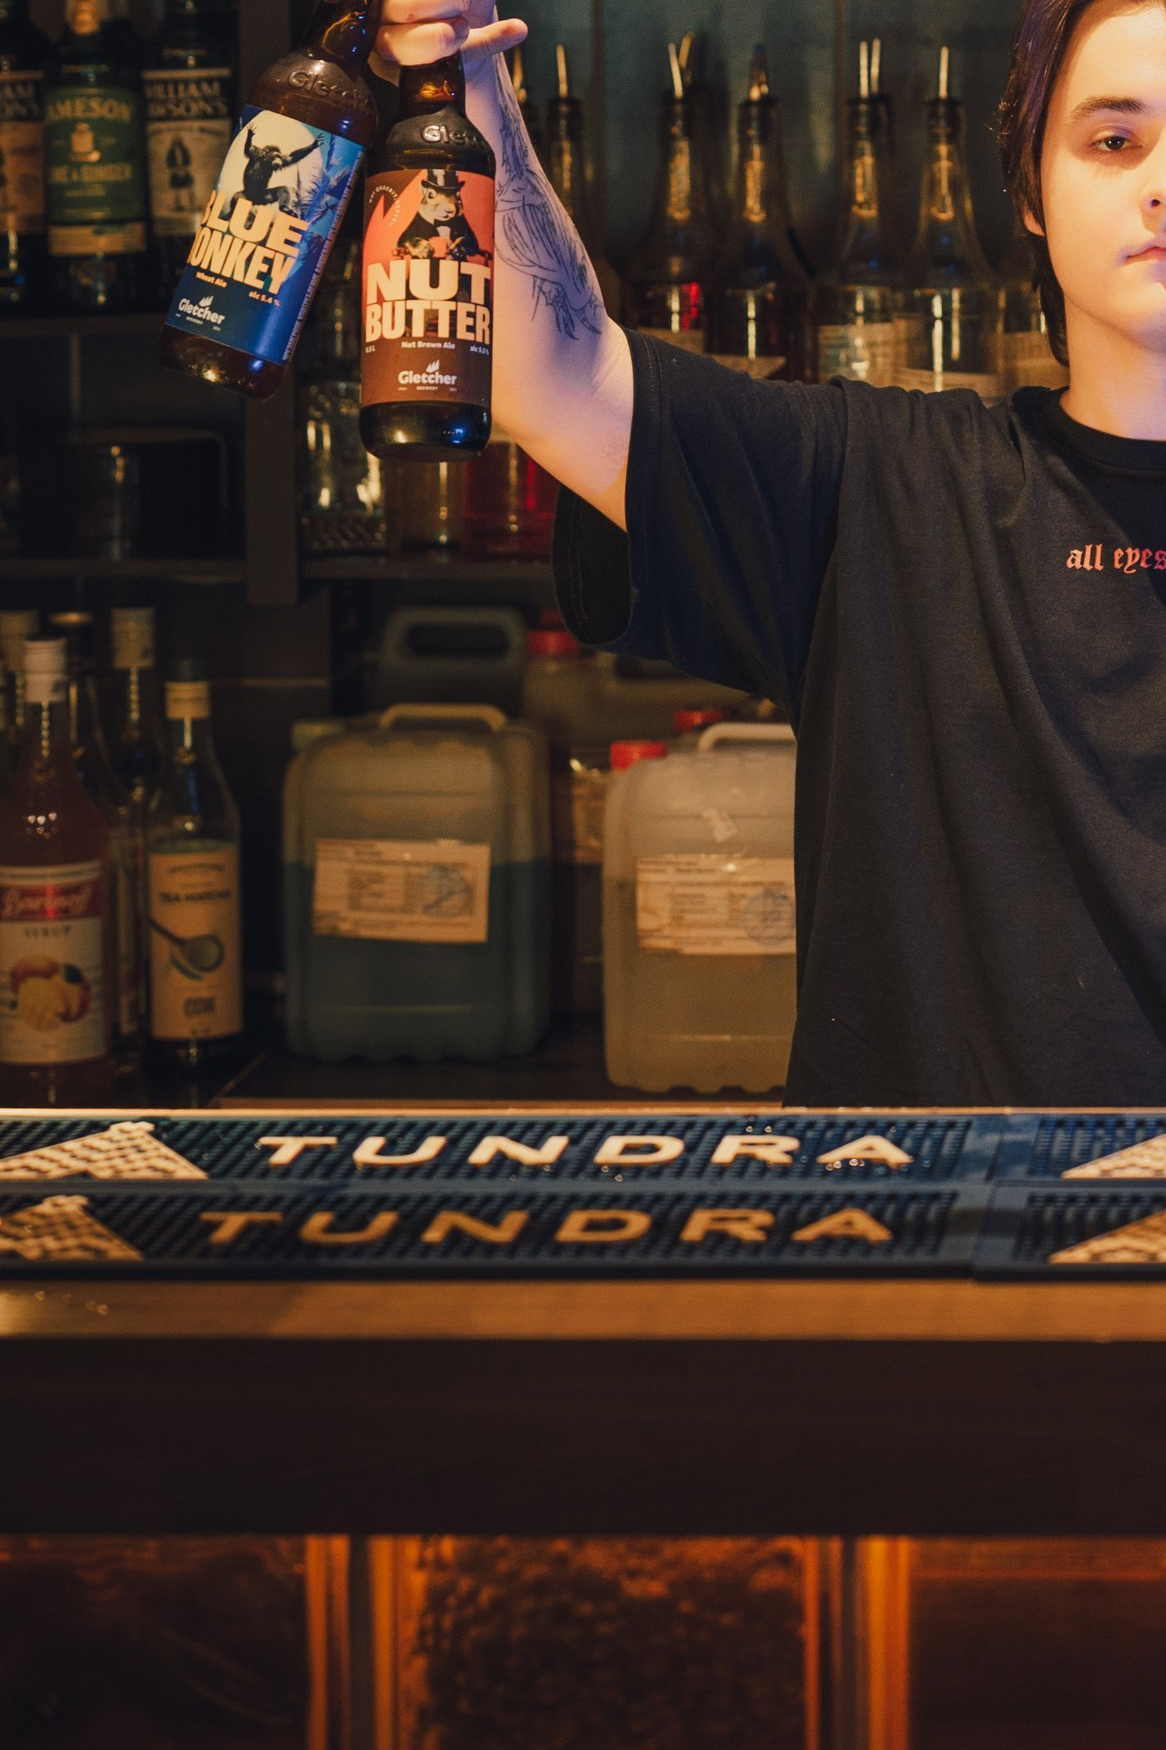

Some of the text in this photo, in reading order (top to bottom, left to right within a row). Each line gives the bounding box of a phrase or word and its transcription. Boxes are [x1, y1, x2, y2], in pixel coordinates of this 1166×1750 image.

[46, 97, 131, 122] AMESON
[186, 224, 296, 295] ONKEY
[367, 258, 491, 306] NUT
[178, 298, 225, 325] Gletcher
[365, 299, 491, 345] BUTTER
[417, 340, 442, 348] Brown
[443, 341, 456, 350] Ale
[398, 370, 458, 385] Gletcher
[1066, 543, 1104, 571] all
[257, 1134, 913, 1167] TUNDRA
[200, 1208, 892, 1244] TUNDRA
